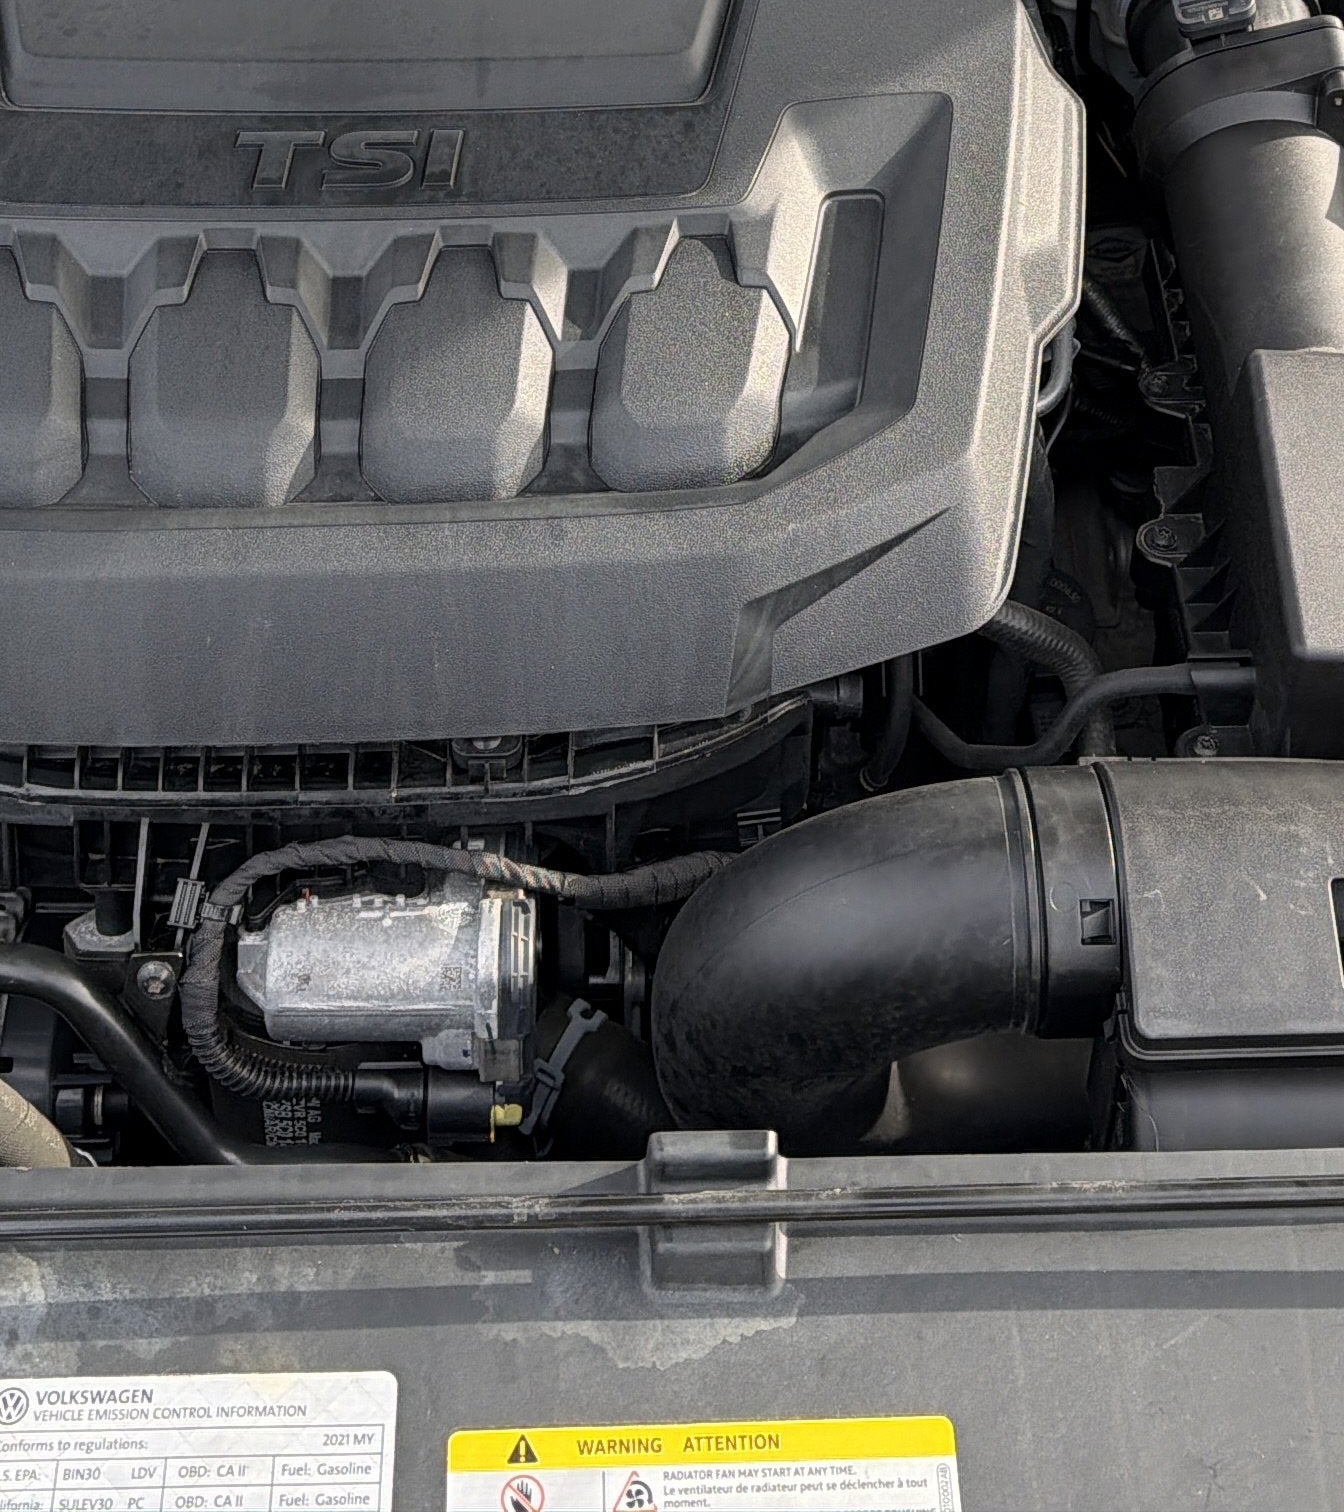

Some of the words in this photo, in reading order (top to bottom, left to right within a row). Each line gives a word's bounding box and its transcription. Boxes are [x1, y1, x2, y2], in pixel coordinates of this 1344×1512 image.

[234, 128, 465, 190] TSI
[36, 1389, 153, 1405] VOLKSWAGEN
[34, 1409, 84, 1421] VEHICLE
[88, 1408, 149, 1420] EMISSION
[153, 1407, 212, 1420] CONTROL
[216, 1405, 306, 1418] INFORMATION
[58, 1439, 71, 1451] to
[74, 1438, 148, 1453] regulations:
[323, 1434, 350, 1446] 2021
[353, 1433, 375, 1445] MY
[577, 1437, 662, 1455] WARNING
[683, 1434, 780, 1452] ATTENTION
[63, 1468, 101, 1481] BIN30
[131, 1466, 157, 1480] LDV
[178, 1465, 210, 1478] OBD:
[217, 1465, 234, 1477] CA
[281, 1464, 311, 1476] Fuel:
[317, 1463, 372, 1476] Gasoline
[663, 1470, 713, 1481] RADIATOR
[716, 1469, 735, 1479] FAN
[738, 1468, 759, 1478] MAY
[761, 1467, 791, 1478] START
[793, 1467, 805, 1477] AT
[808, 1466, 827, 1476] ANY
[829, 1465, 857, 1476] TIME.
[663, 1485, 675, 1496] Le
[678, 1484, 733, 1495] ventilateur
[736, 1483, 748, 1494] de
[751, 1483, 797, 1493] radiateur
[800, 1481, 823, 1494] peut
[826, 1482, 836, 1491] se
[840, 1479, 894, 1490] déclencher
[897, 1478, 903, 1488] à
[906, 1478, 927, 1488] tout
[59, 1498, 113, 1511] SULEV30
[128, 1497, 145, 1509] PC
[175, 1495, 208, 1509] OBD:
[214, 1495, 231, 1507] CA
[279, 1494, 309, 1507] Fuel:
[315, 1493, 370, 1506] Gasoline
[664, 1498, 711, 1508] moment.
